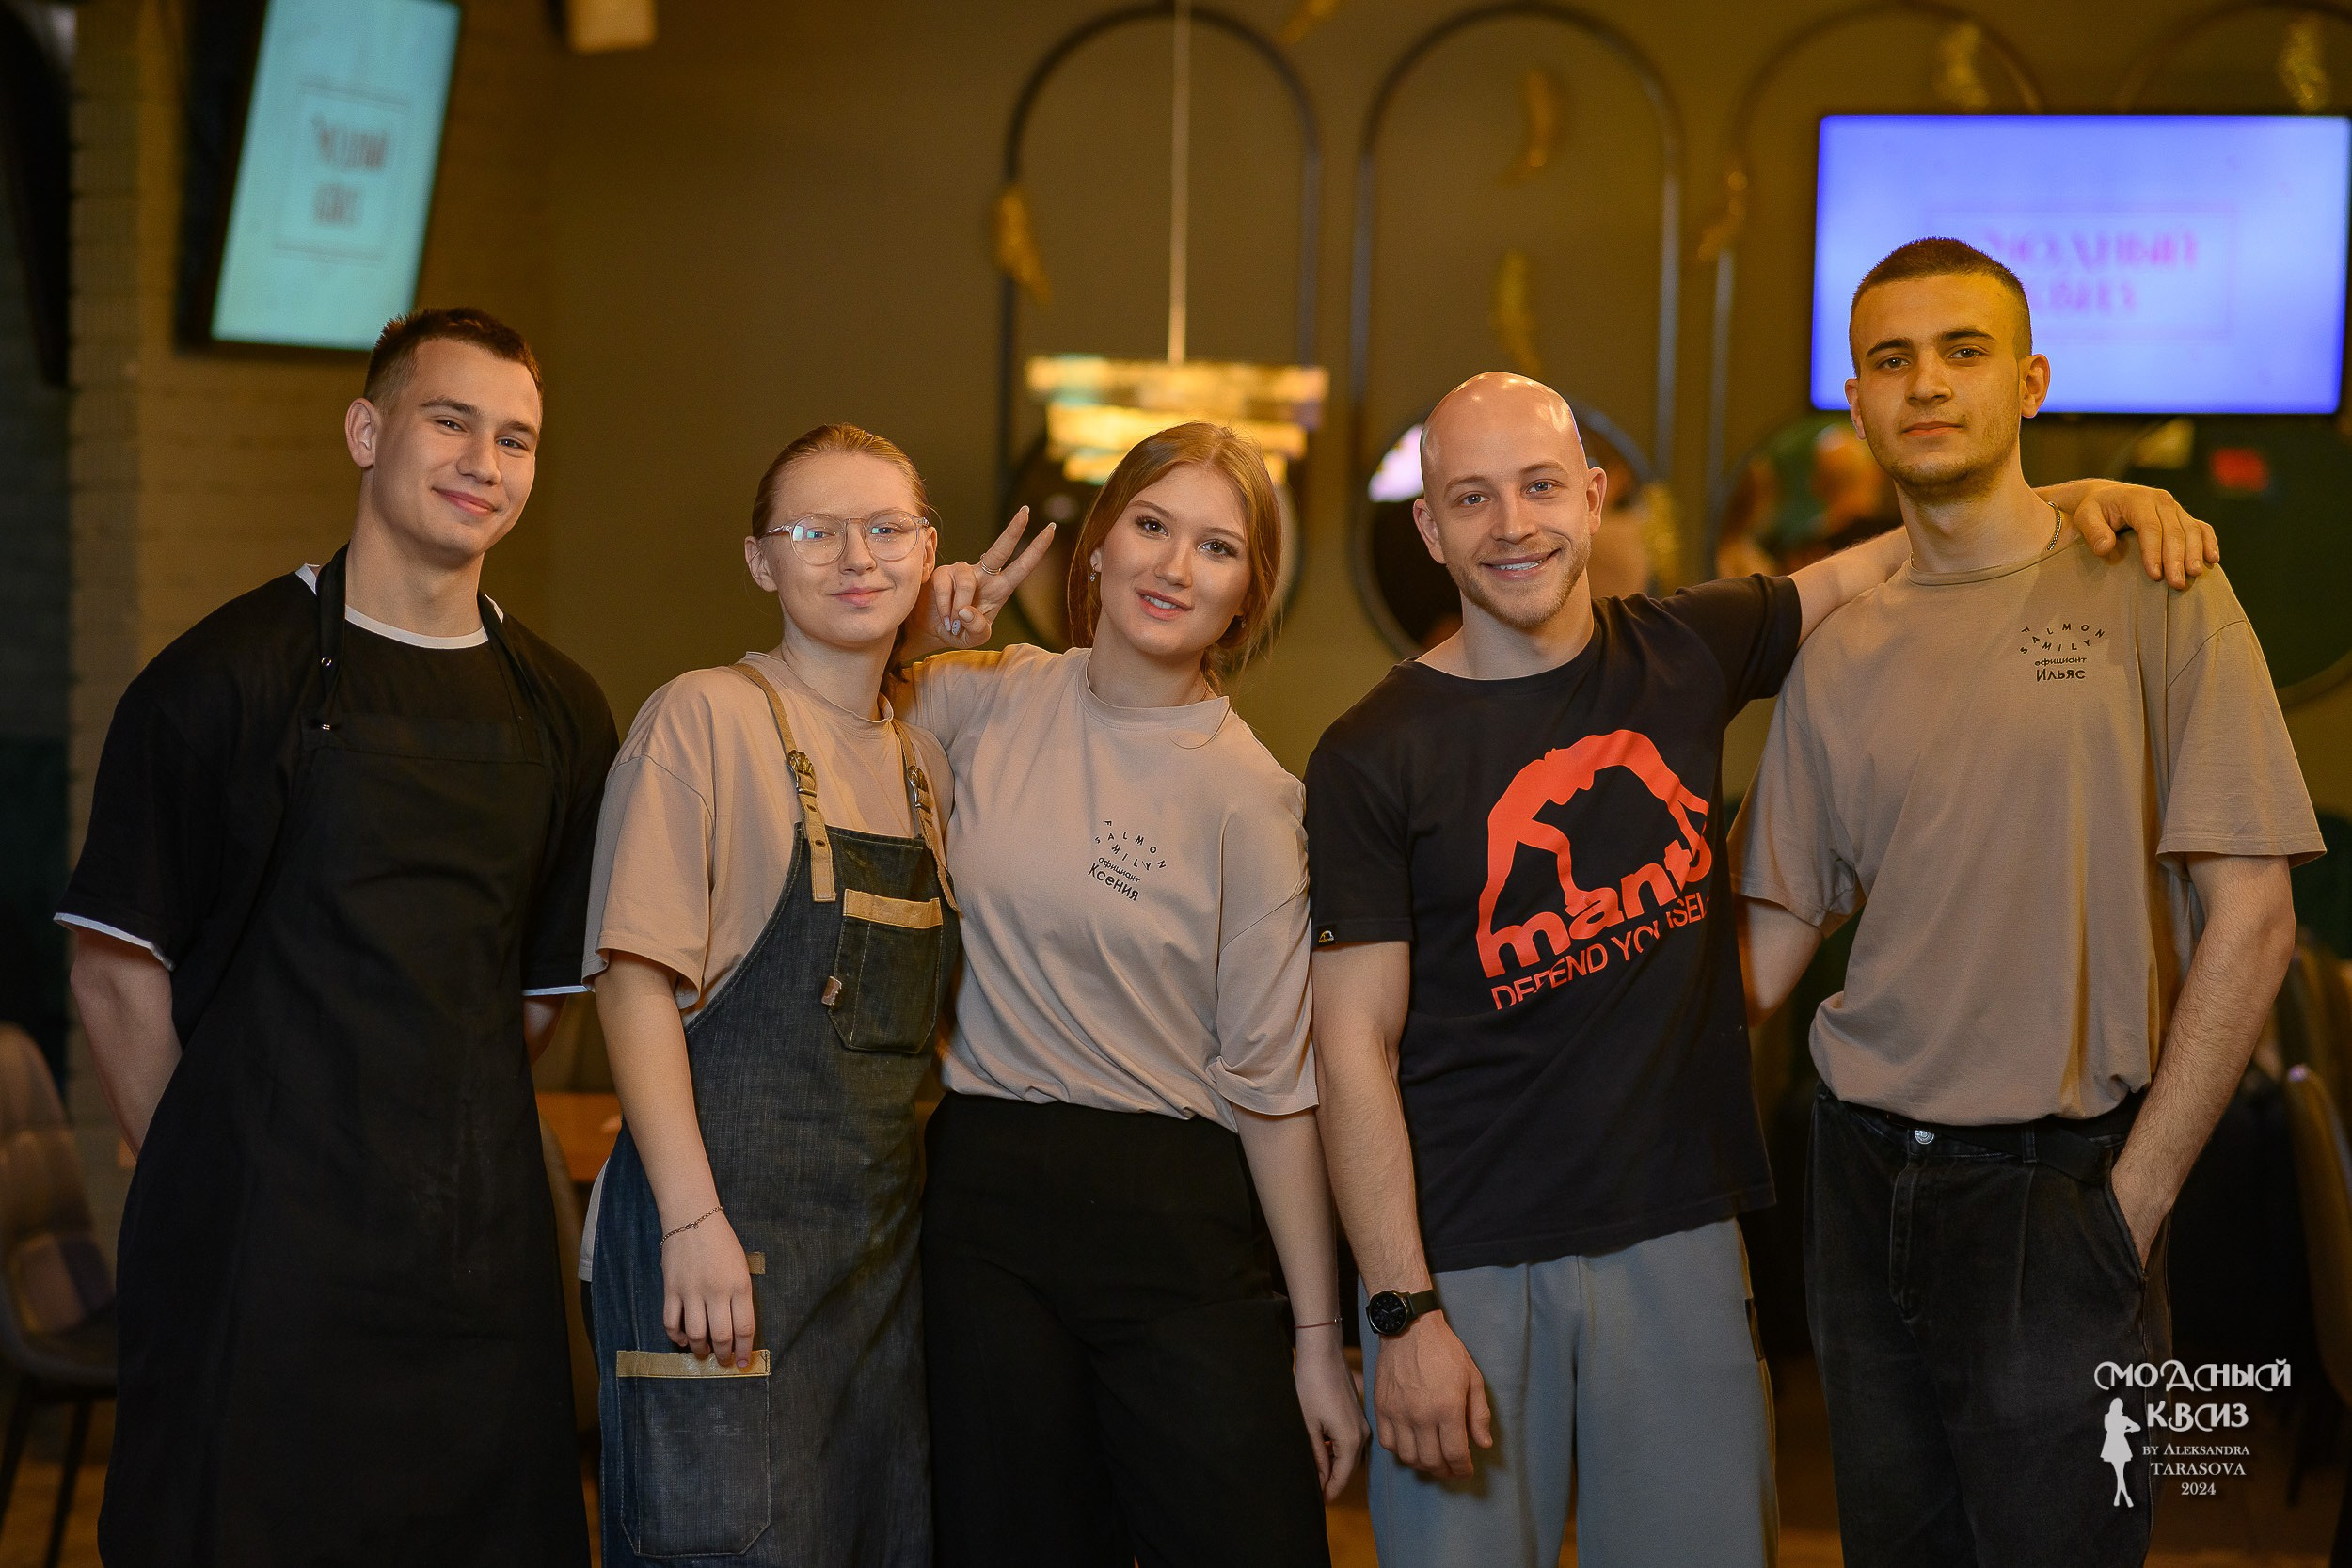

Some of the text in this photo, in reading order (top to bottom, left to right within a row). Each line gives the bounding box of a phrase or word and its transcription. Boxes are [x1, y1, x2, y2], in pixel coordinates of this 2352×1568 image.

[2034, 657, 2088, 667] официант
[2036, 668, 2086, 682] Ильяс
[1088, 862, 1139, 902] Ксения
